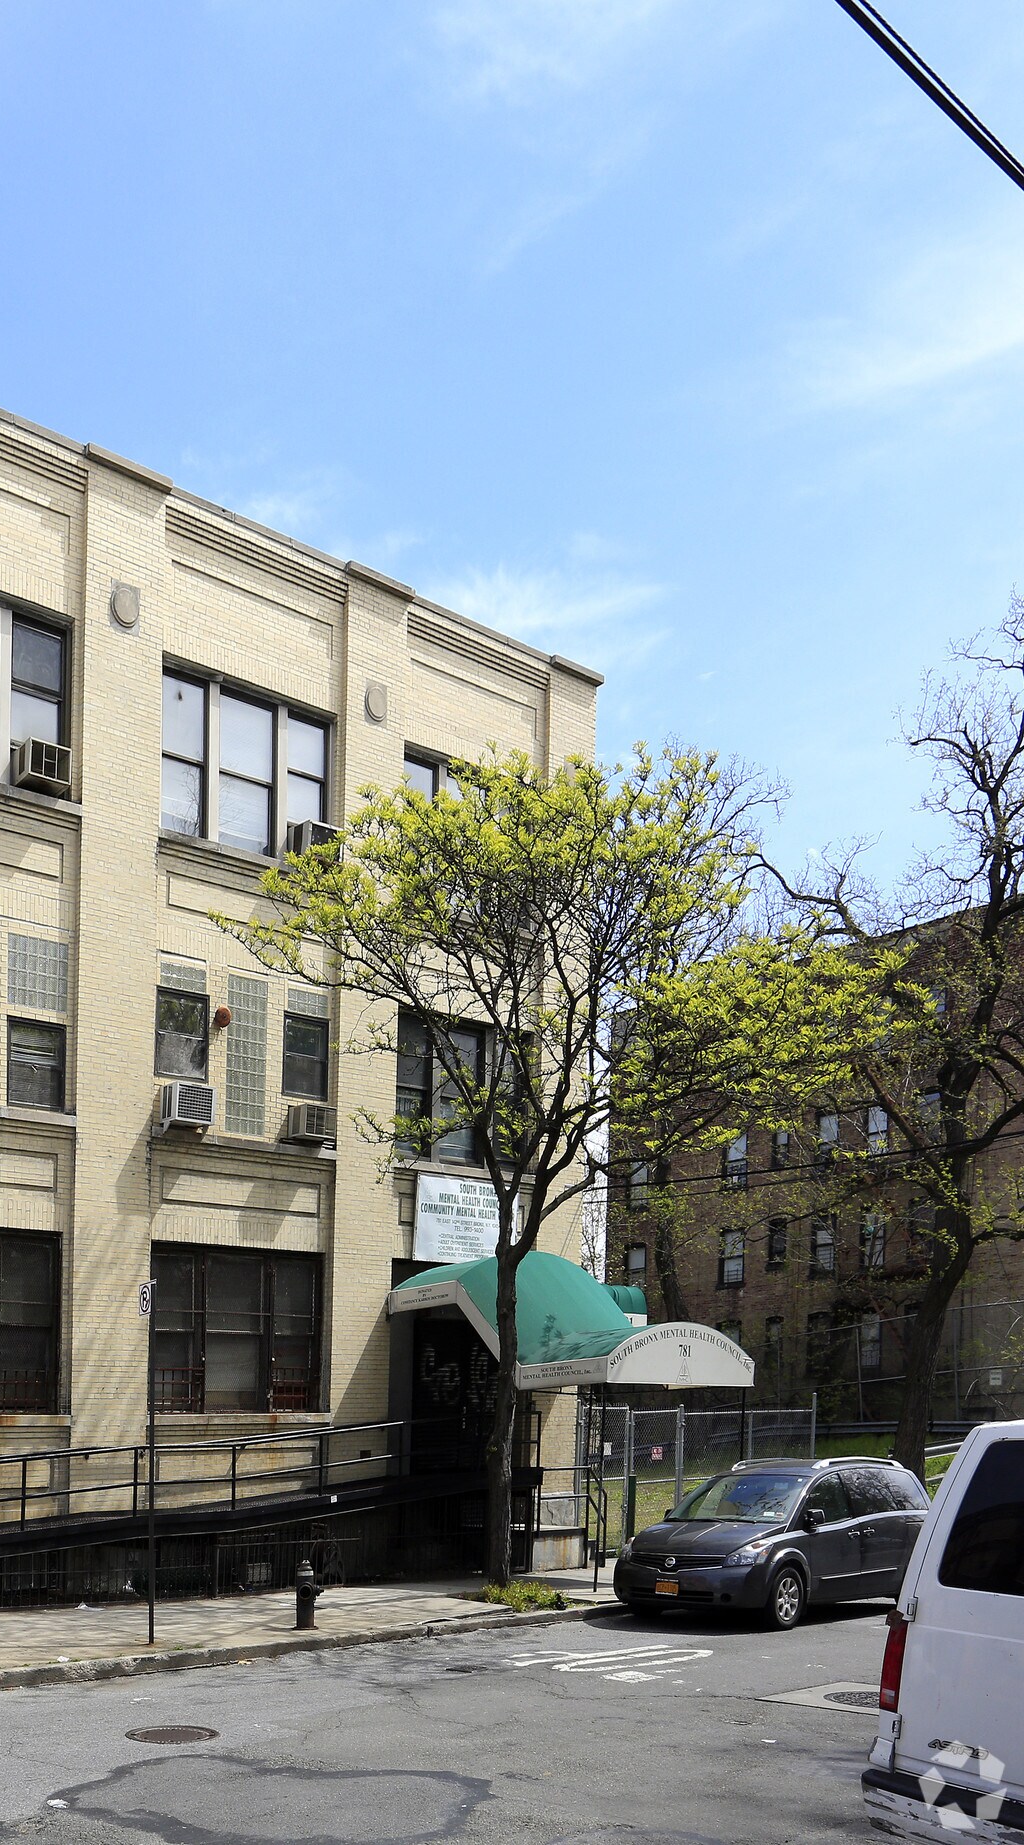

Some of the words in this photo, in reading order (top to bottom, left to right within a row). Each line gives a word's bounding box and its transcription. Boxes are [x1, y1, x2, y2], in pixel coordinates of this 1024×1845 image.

[460, 1184, 476, 1194] SOUTH
[439, 1193, 460, 1204] MENTAL
[462, 1196, 480, 1207] HEALTH
[420, 1202, 454, 1215] COMMUNITY
[456, 1206, 476, 1217] MENTAL
[478, 1209, 496, 1219] HEALTH
[609, 1348, 634, 1369] SOUTH
[634, 1333, 658, 1350] BRONX
[660, 1328, 688, 1340] MENTAL
[689, 1328, 716, 1345] HEALTH
[678, 1344, 691, 1357] 781
[928, 1738, 989, 1760] ASTRO
